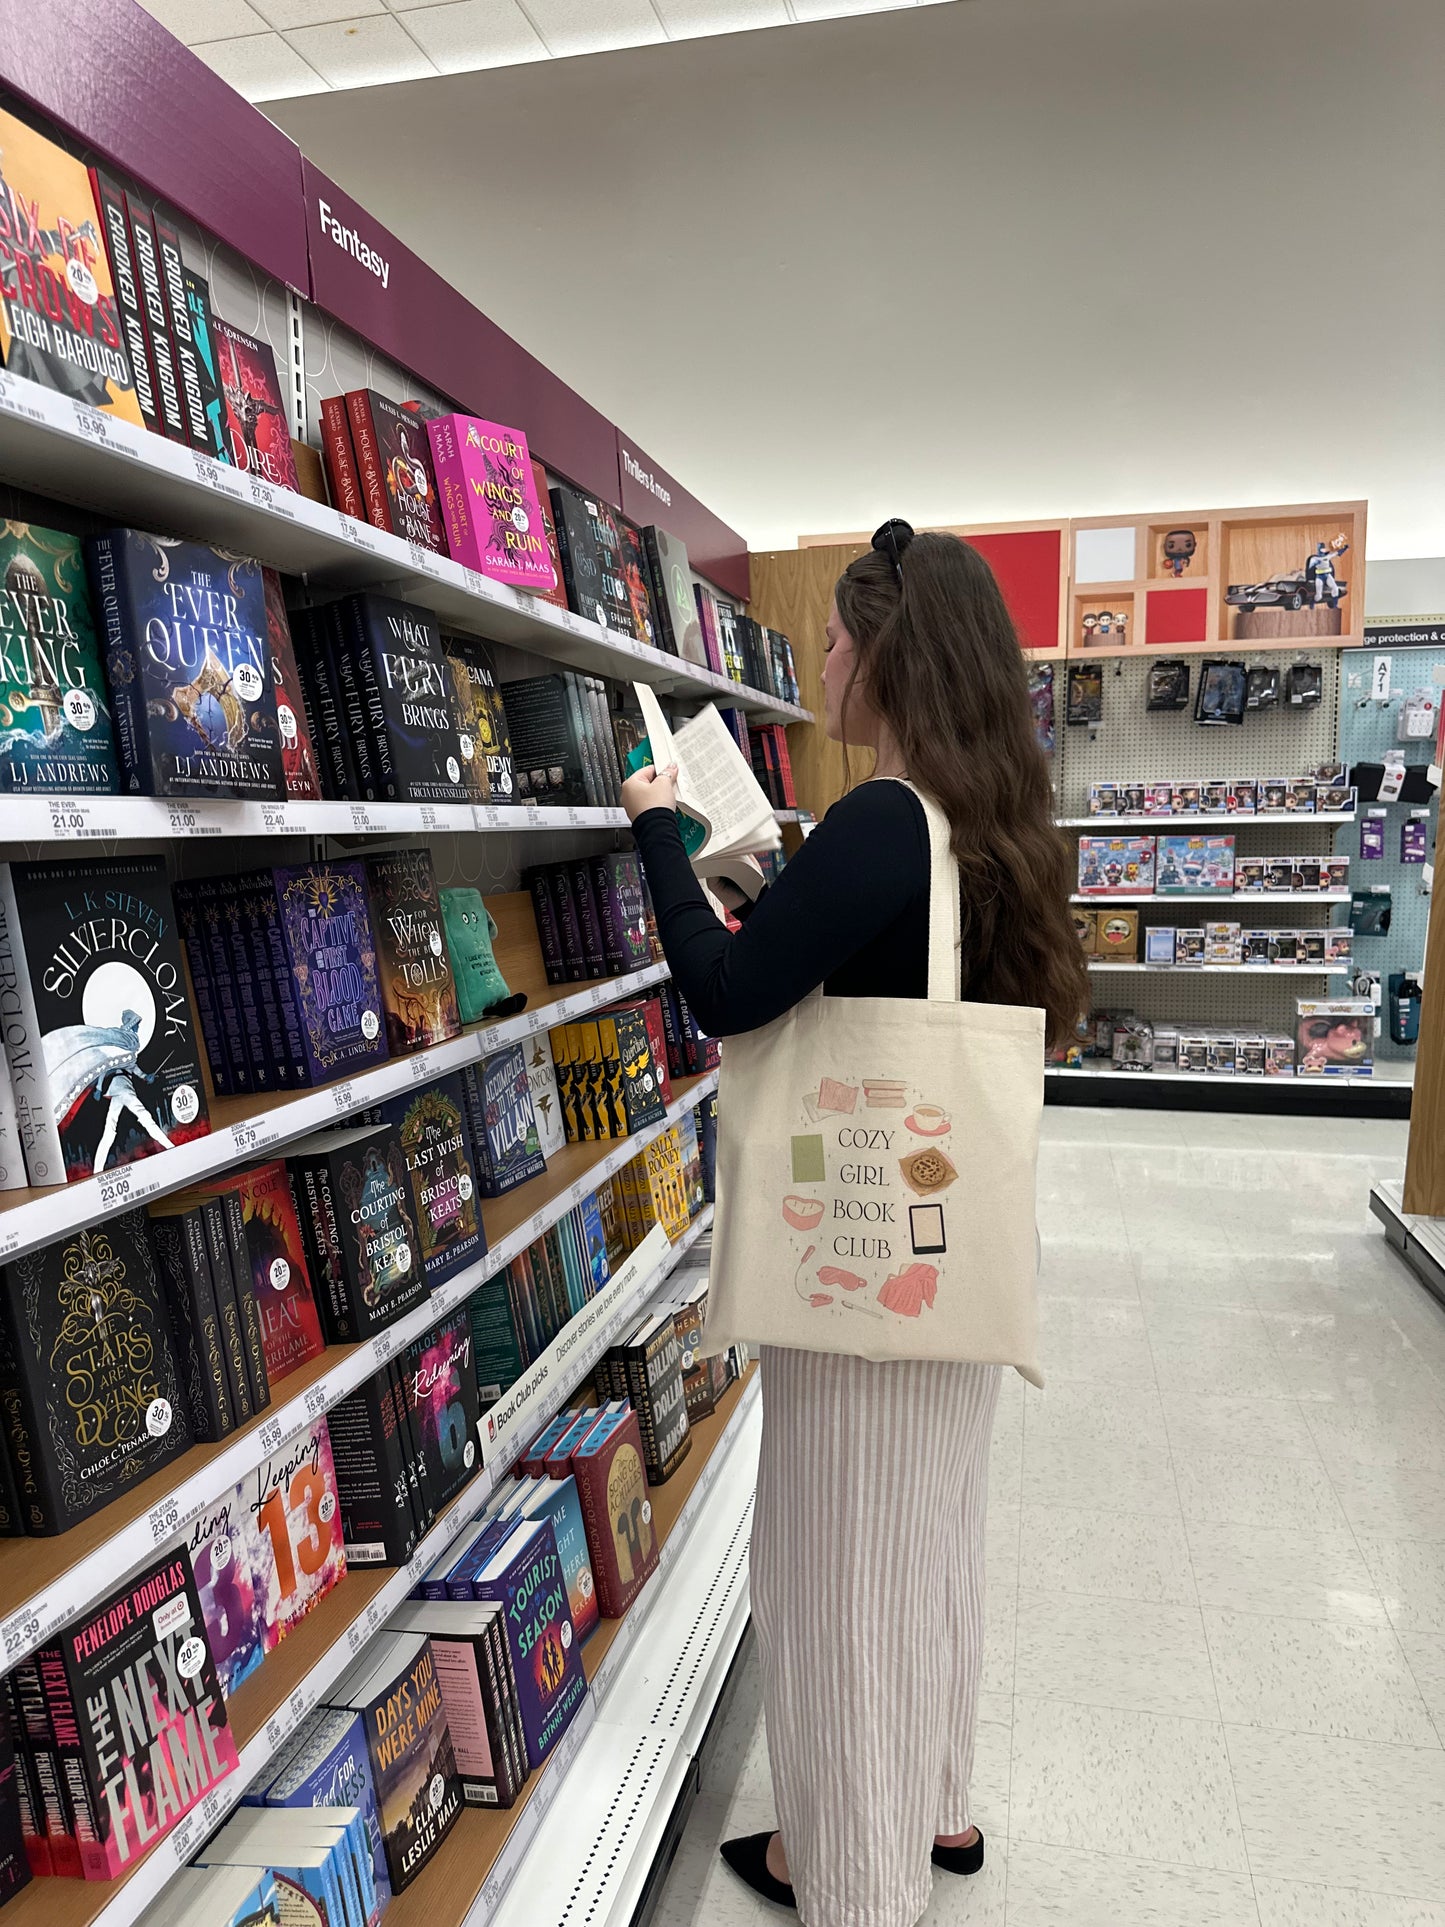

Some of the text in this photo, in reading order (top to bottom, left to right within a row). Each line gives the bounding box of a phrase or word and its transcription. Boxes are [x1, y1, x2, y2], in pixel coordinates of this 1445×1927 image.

[318, 198, 390, 289] Fantasy
[107, 203, 156, 418] CROOKED KINGDOM
[135, 224, 182, 430] CROOKED KINGDOM
[162, 242, 209, 442] CROOKED KINGDOM
[8, 304, 129, 385] LEIGH BARDUGO
[76, 414, 107, 437] 15.99
[443, 424, 455, 459] SARAH
[333, 436, 347, 469] HOUSE
[359, 427, 374, 464] HOUSE
[433, 432, 447, 464] MAAS
[480, 434, 526, 461] COURT
[195, 463, 218, 481] 15.99
[512, 466, 525, 480] OF
[622, 449, 671, 507] Thrillers & more
[470, 478, 524, 505] WINGS
[443, 477, 463, 548] WINGS RUIN
[455, 493, 467, 527] COURT
[492, 508, 513, 523] AND
[505, 532, 543, 553] RUIN
[191, 570, 212, 590] THE
[485, 554, 551, 574] SARAH MAAS
[14, 572, 38, 592] THE
[96, 538, 123, 648] THE EVER QUEEN
[164, 583, 246, 634] EVER
[146, 617, 266, 680] QUEEN
[387, 616, 431, 652] WHAT
[1378, 631, 1429, 645] protection
[1430, 631, 1438, 640] &
[238, 669, 252, 684] 30
[382, 652, 447, 698] FURY
[69, 701, 84, 716] 30
[401, 703, 450, 731] BRINGS
[115, 693, 134, 769] LJ ANDREWS
[10, 761, 110, 783] LJ ANDREWS
[175, 755, 271, 781] LJ ANDREWS
[49, 801, 77, 809] THE EVER
[170, 814, 196, 827] 21.00
[264, 814, 285, 827] 22.40
[353, 815, 370, 825] 21.00
[52, 814, 84, 829] 21.00
[376, 864, 408, 878] JAYSEA
[104, 890, 169, 939] STEVEN
[413, 909, 428, 920] FOR
[407, 946, 425, 958] THE
[43, 918, 187, 1043] SILVERCLOAK
[311, 962, 364, 1012] BLOOD
[398, 955, 449, 989] TOLLS
[348, 1043, 367, 1057] LINDE
[485, 1052, 525, 1104] ACCOMPLICE
[175, 1095, 188, 1110] 30
[334, 1092, 352, 1108] 15.99
[17, 1096, 37, 1151] STEVEN
[233, 1130, 257, 1149] 16.79
[425, 1125, 442, 1143] The
[490, 1096, 535, 1161] VILLAIN
[838, 1127, 896, 1150] COZY
[405, 1132, 465, 1172] LAST WISH
[648, 1146, 681, 1177] ROONEY
[435, 1160, 446, 1178] of
[840, 1163, 891, 1187] GIRL
[101, 1181, 131, 1202] 23.09
[370, 1178, 386, 1196] The
[233, 1200, 243, 1232] CHLOE
[304, 1171, 328, 1256] BRISTOL KEATS
[350, 1186, 406, 1225] COURTING
[380, 1212, 389, 1230] of
[429, 1193, 463, 1224] KEATS
[833, 1199, 896, 1223] BOOK
[193, 1220, 204, 1254] CHLOE
[213, 1209, 224, 1244] CHLOE
[366, 1223, 408, 1258] BRISTOL
[424, 1233, 479, 1273] MARY PEARSON
[833, 1235, 892, 1260] CLUB
[368, 1281, 424, 1321] MARY PEARSON
[278, 1332, 293, 1347] THE
[440, 1312, 468, 1340] WALSH
[374, 1341, 391, 1359] 15.99
[496, 1400, 517, 1431] Book
[515, 1385, 532, 1412] Club
[531, 1365, 549, 1396] picks
[555, 1328, 578, 1363] Discover
[577, 1312, 596, 1340] stories
[594, 1303, 605, 1319] we
[602, 1293, 614, 1311] love
[612, 1278, 626, 1303] every
[646, 1337, 680, 1388] BILLION
[100, 1367, 125, 1390] ARE
[411, 1335, 471, 1407] Redeeming
[628, 1360, 641, 1394] BILLION
[684, 1376, 706, 1395] LIKE
[152, 1405, 165, 1420] 30
[306, 1394, 326, 1413] 15.99
[652, 1374, 685, 1426] DOLLAR
[261, 1427, 283, 1449] 15.99
[80, 1448, 121, 1480] CHLOE C.
[250, 1432, 323, 1514] Keeping
[581, 1477, 592, 1509] SONG
[151, 1509, 179, 1540] 23.09
[256, 1462, 333, 1601] 13
[214, 1543, 224, 1556] 20
[563, 1548, 587, 1581] HERE
[508, 1552, 557, 1626] TOURIST
[1, 1608, 33, 1635] SCARRED
[72, 1598, 134, 1664] PENELOPE
[132, 1560, 186, 1618] DOUGLAS
[157, 1611, 171, 1624] Only
[517, 1582, 565, 1660] SEASON
[5, 1618, 41, 1654] 22.39
[180, 1648, 193, 1663] 20
[38, 1650, 81, 1749] THE NEXT FLAME
[111, 1615, 209, 1759] NEXT
[375, 1651, 433, 1736] DAYS YOU
[376, 1678, 443, 1773] WERE MINE
[537, 1674, 585, 1751] BRYNNE WEAVER
[86, 1686, 120, 1780] THE
[104, 1694, 229, 1864] FLAME
[204, 1800, 219, 1821] 12.00
[174, 1833, 190, 1856] 12.00
[401, 1790, 459, 1873] LESLIE HALL
